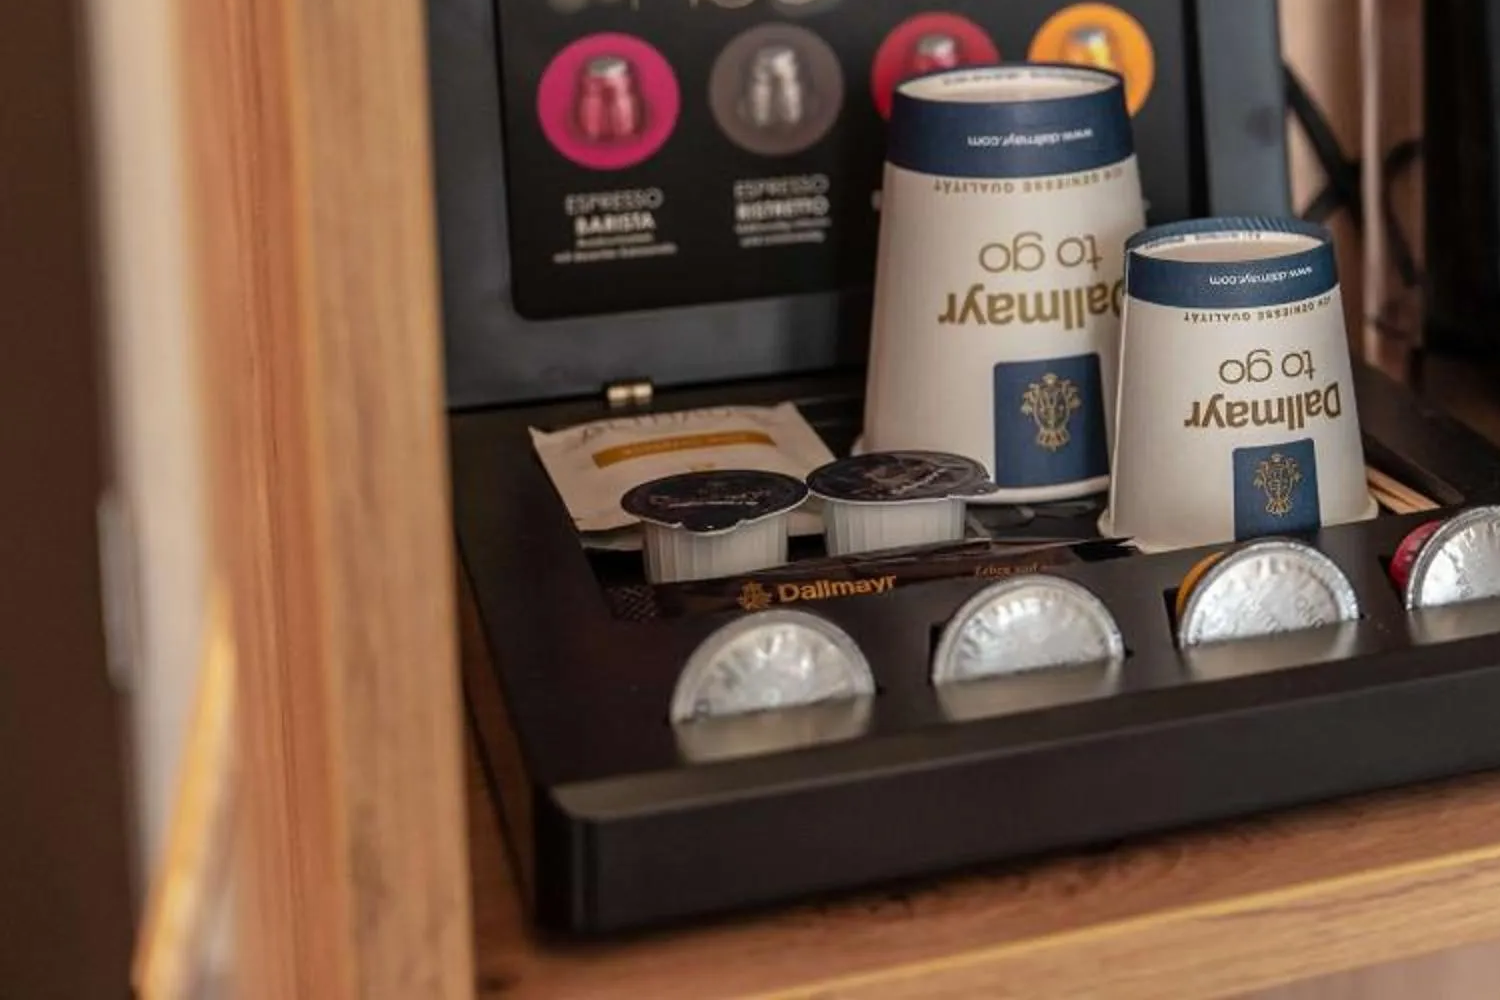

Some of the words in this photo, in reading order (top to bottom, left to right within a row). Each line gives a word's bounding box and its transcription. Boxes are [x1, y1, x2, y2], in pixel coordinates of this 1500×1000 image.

[932, 179, 1016, 195] QUALITÄT
[978, 231, 1049, 273] go
[1056, 233, 1103, 270] to
[1182, 310, 1252, 324] QUALITÄT
[1219, 350, 1273, 385] go
[1280, 349, 1317, 379] to
[1184, 381, 1341, 430] Dallmayr
[778, 573, 897, 604] Dallmayr
